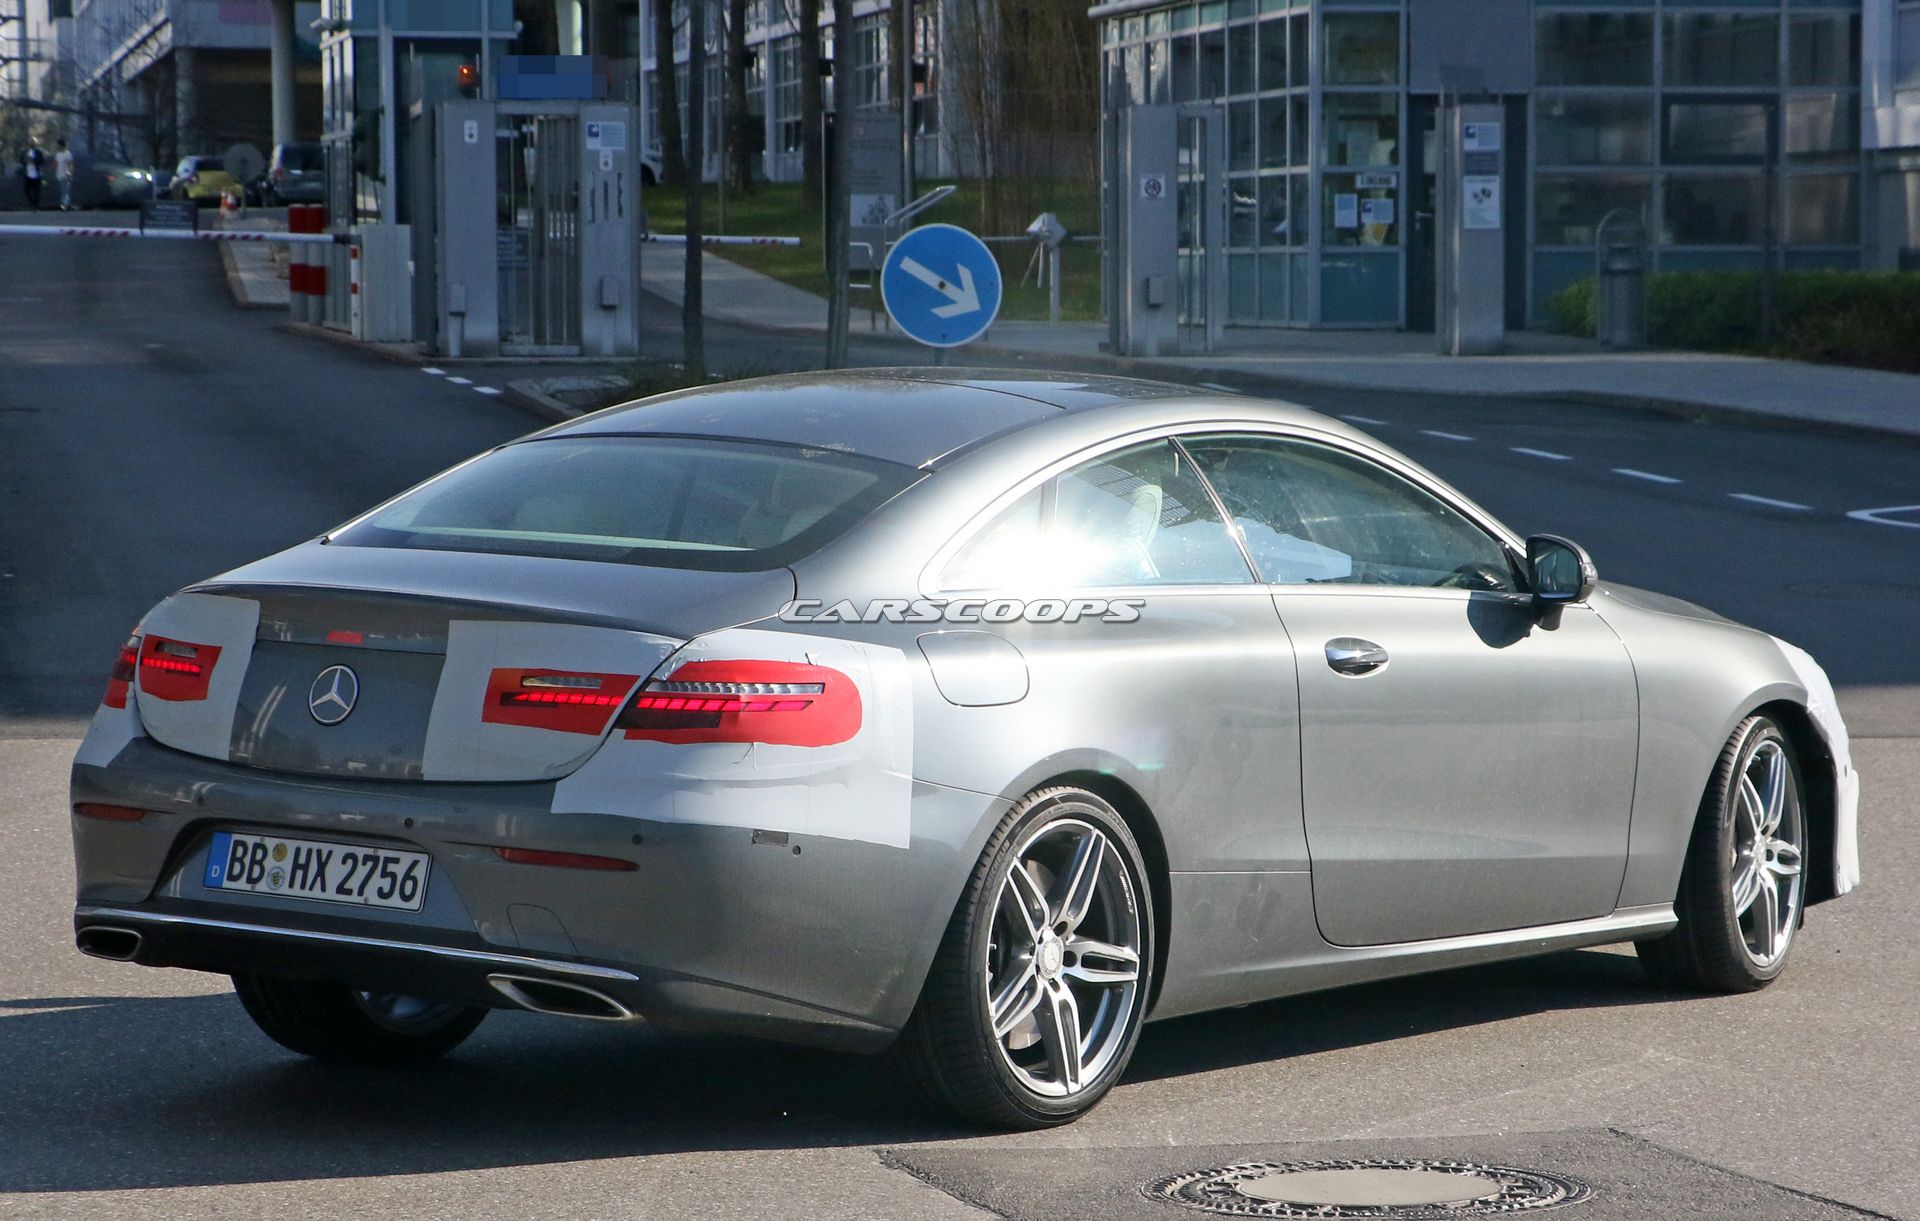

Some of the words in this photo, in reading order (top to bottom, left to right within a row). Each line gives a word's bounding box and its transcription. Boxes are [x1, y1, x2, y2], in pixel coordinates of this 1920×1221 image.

[211, 865, 220, 878] D
[226, 839, 268, 885] BB
[288, 846, 333, 893] HX
[335, 852, 420, 902] 2756
